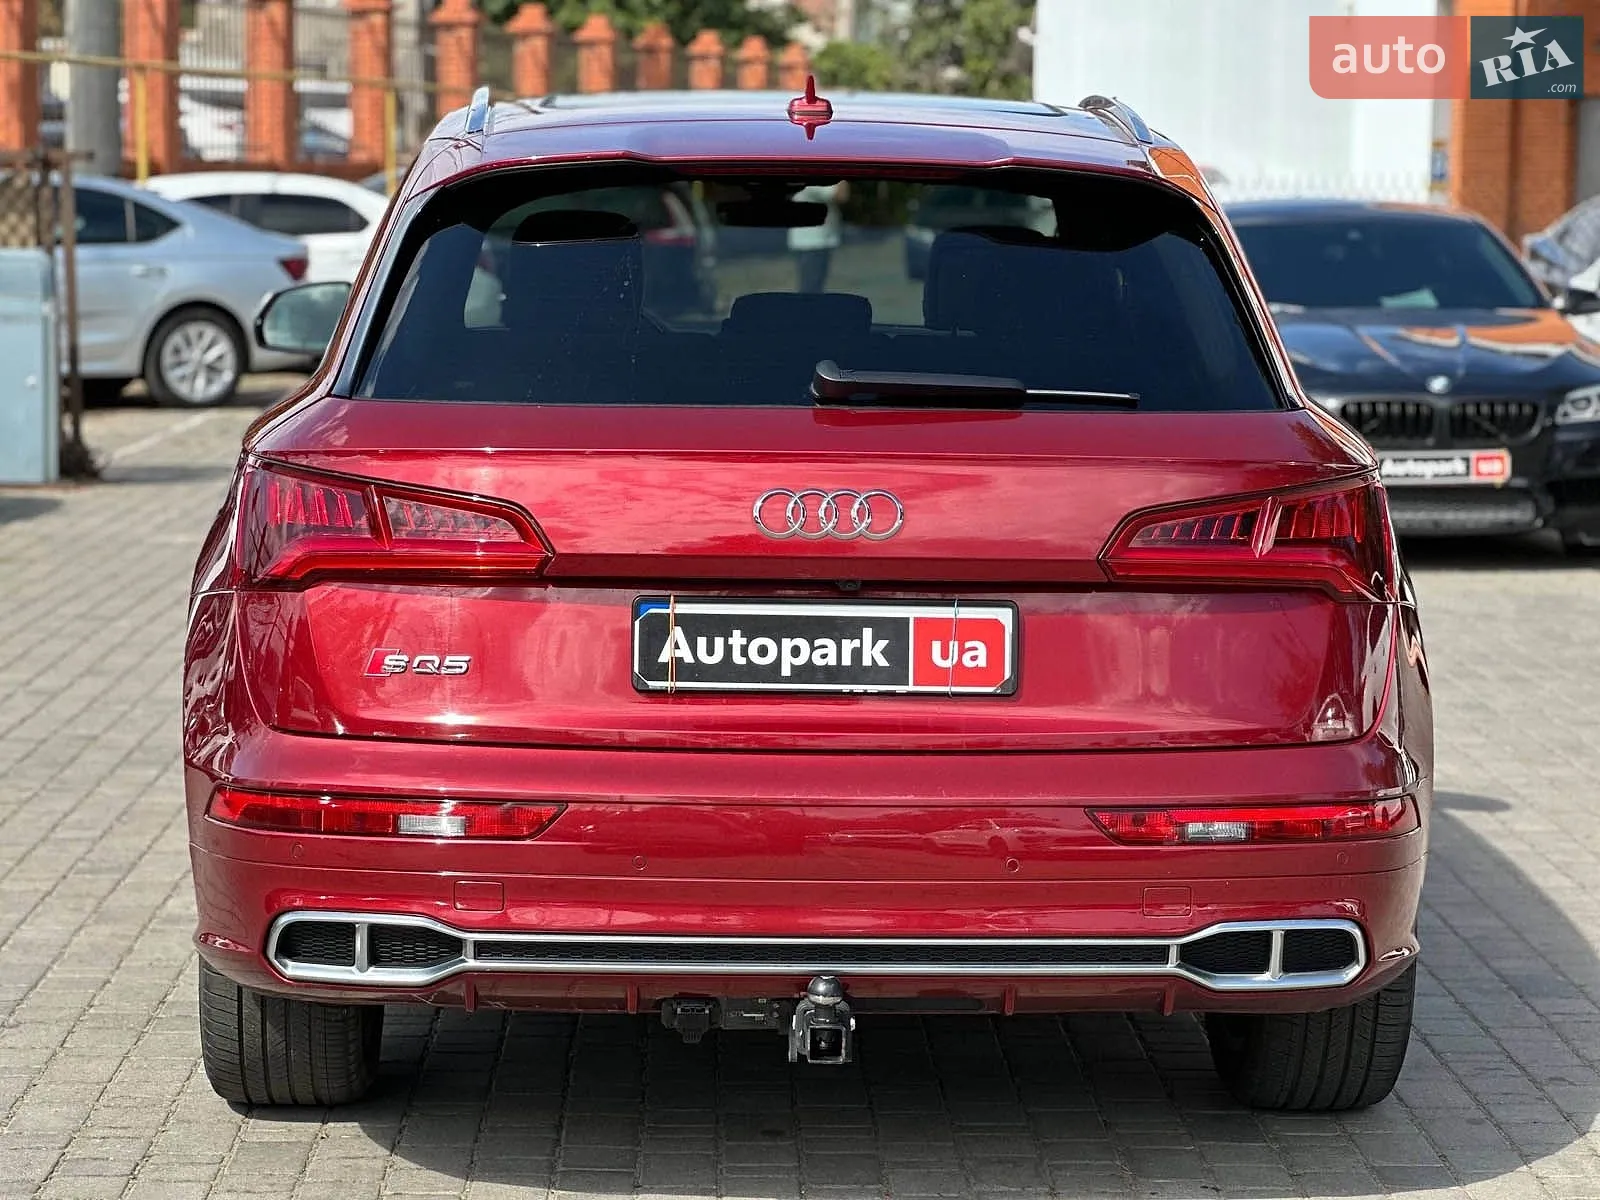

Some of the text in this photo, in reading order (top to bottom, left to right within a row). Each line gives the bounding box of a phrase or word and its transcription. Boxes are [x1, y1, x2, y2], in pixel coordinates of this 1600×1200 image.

[381, 654, 472, 674] SQ5
[657, 625, 988, 677] Autopark ua
